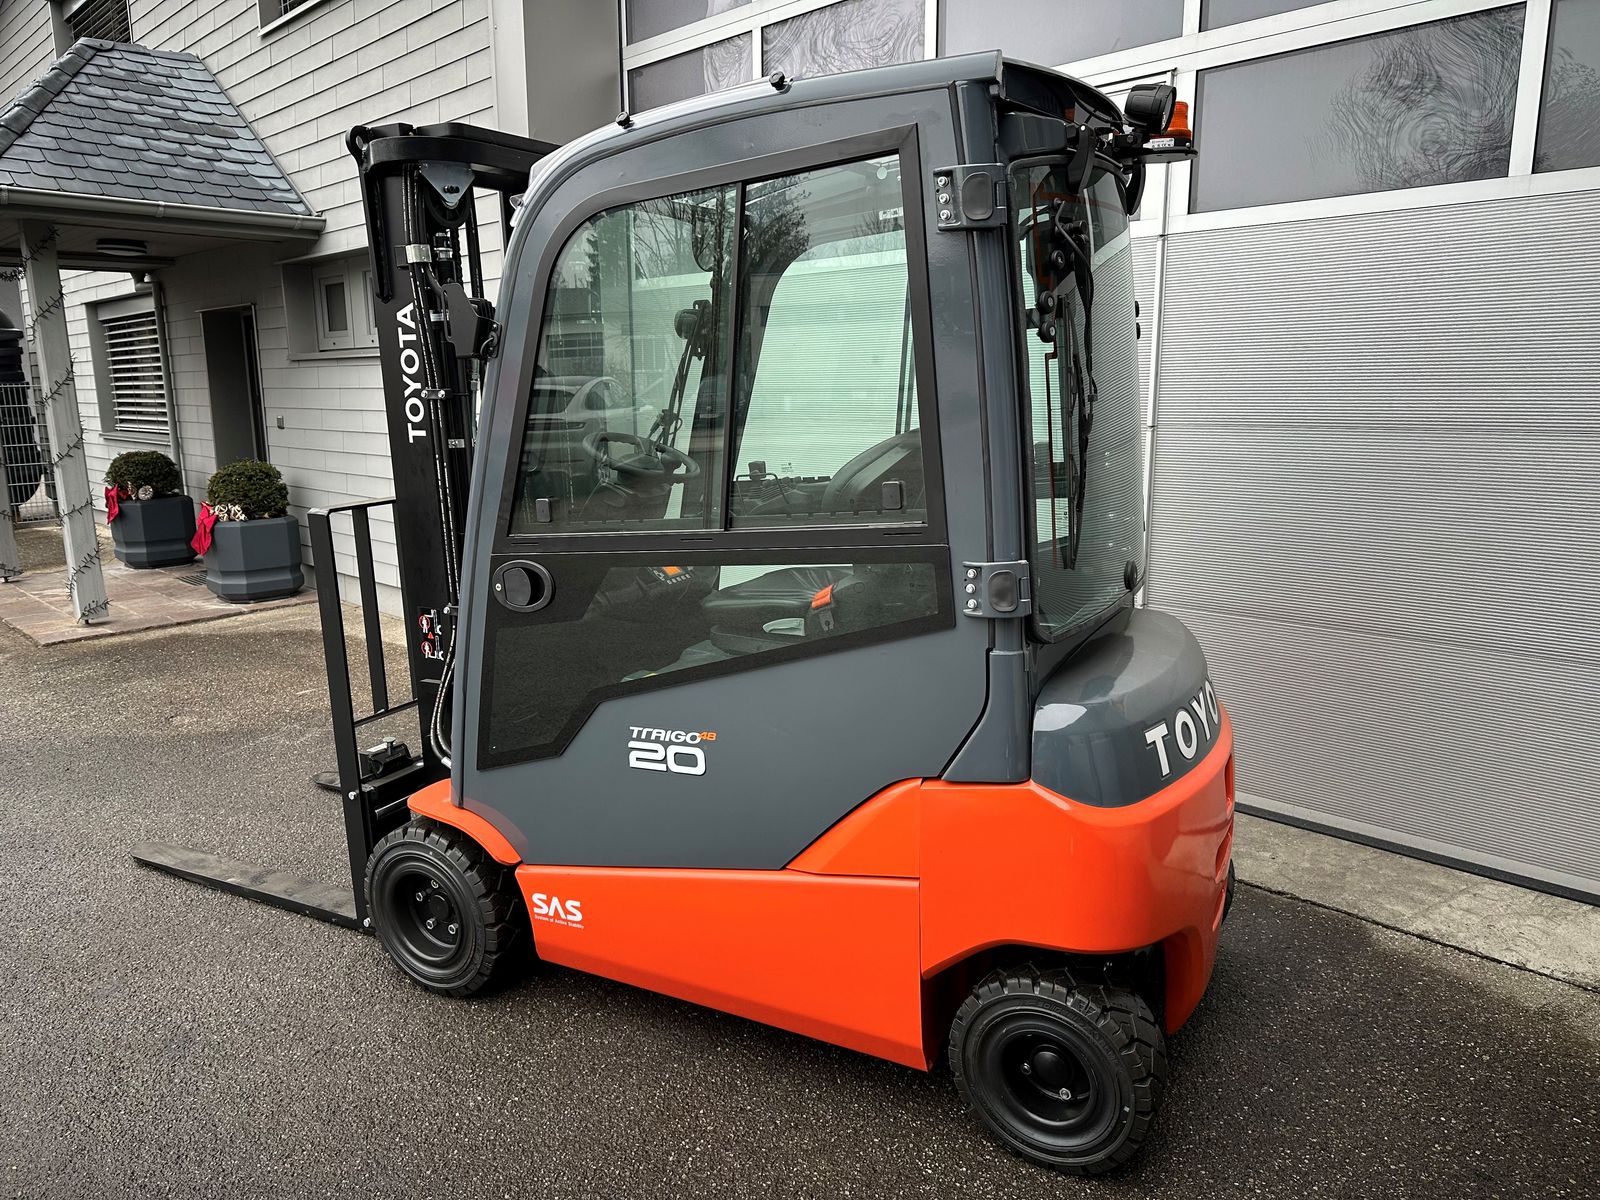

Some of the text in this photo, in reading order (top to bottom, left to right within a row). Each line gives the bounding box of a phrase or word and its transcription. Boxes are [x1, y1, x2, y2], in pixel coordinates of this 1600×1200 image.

[396, 302, 427, 443] TOYOTA
[628, 740, 706, 776] 20
[531, 892, 583, 922] SAS
